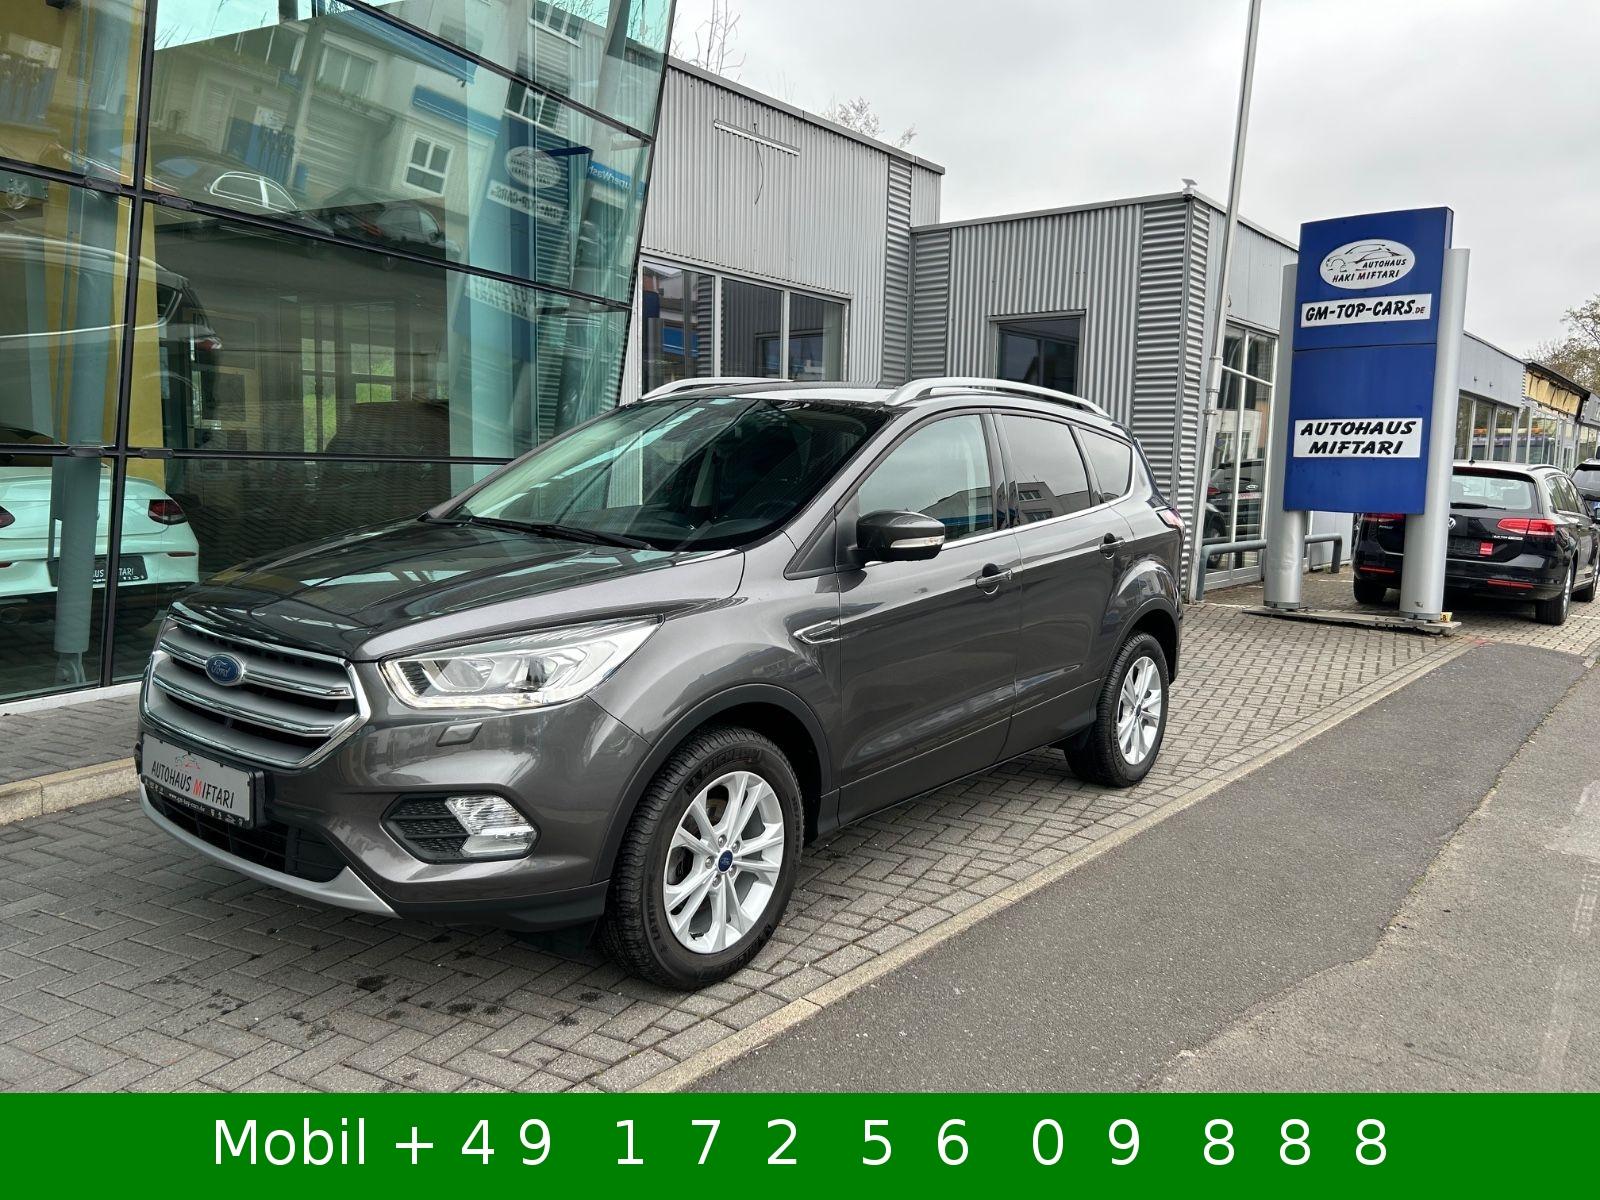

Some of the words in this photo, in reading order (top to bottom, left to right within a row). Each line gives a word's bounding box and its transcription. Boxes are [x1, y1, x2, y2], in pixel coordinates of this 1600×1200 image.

[1362, 258, 1407, 269] AUTOHAUS
[1332, 273, 1355, 283] HAKI
[1357, 269, 1400, 281] MIFTARI
[1300, 421, 1417, 436] AUTOHAUS
[1308, 440, 1404, 455] MIFTARI
[151, 761, 192, 792] AUTOHAUS
[192, 779, 235, 809] MIFTARI
